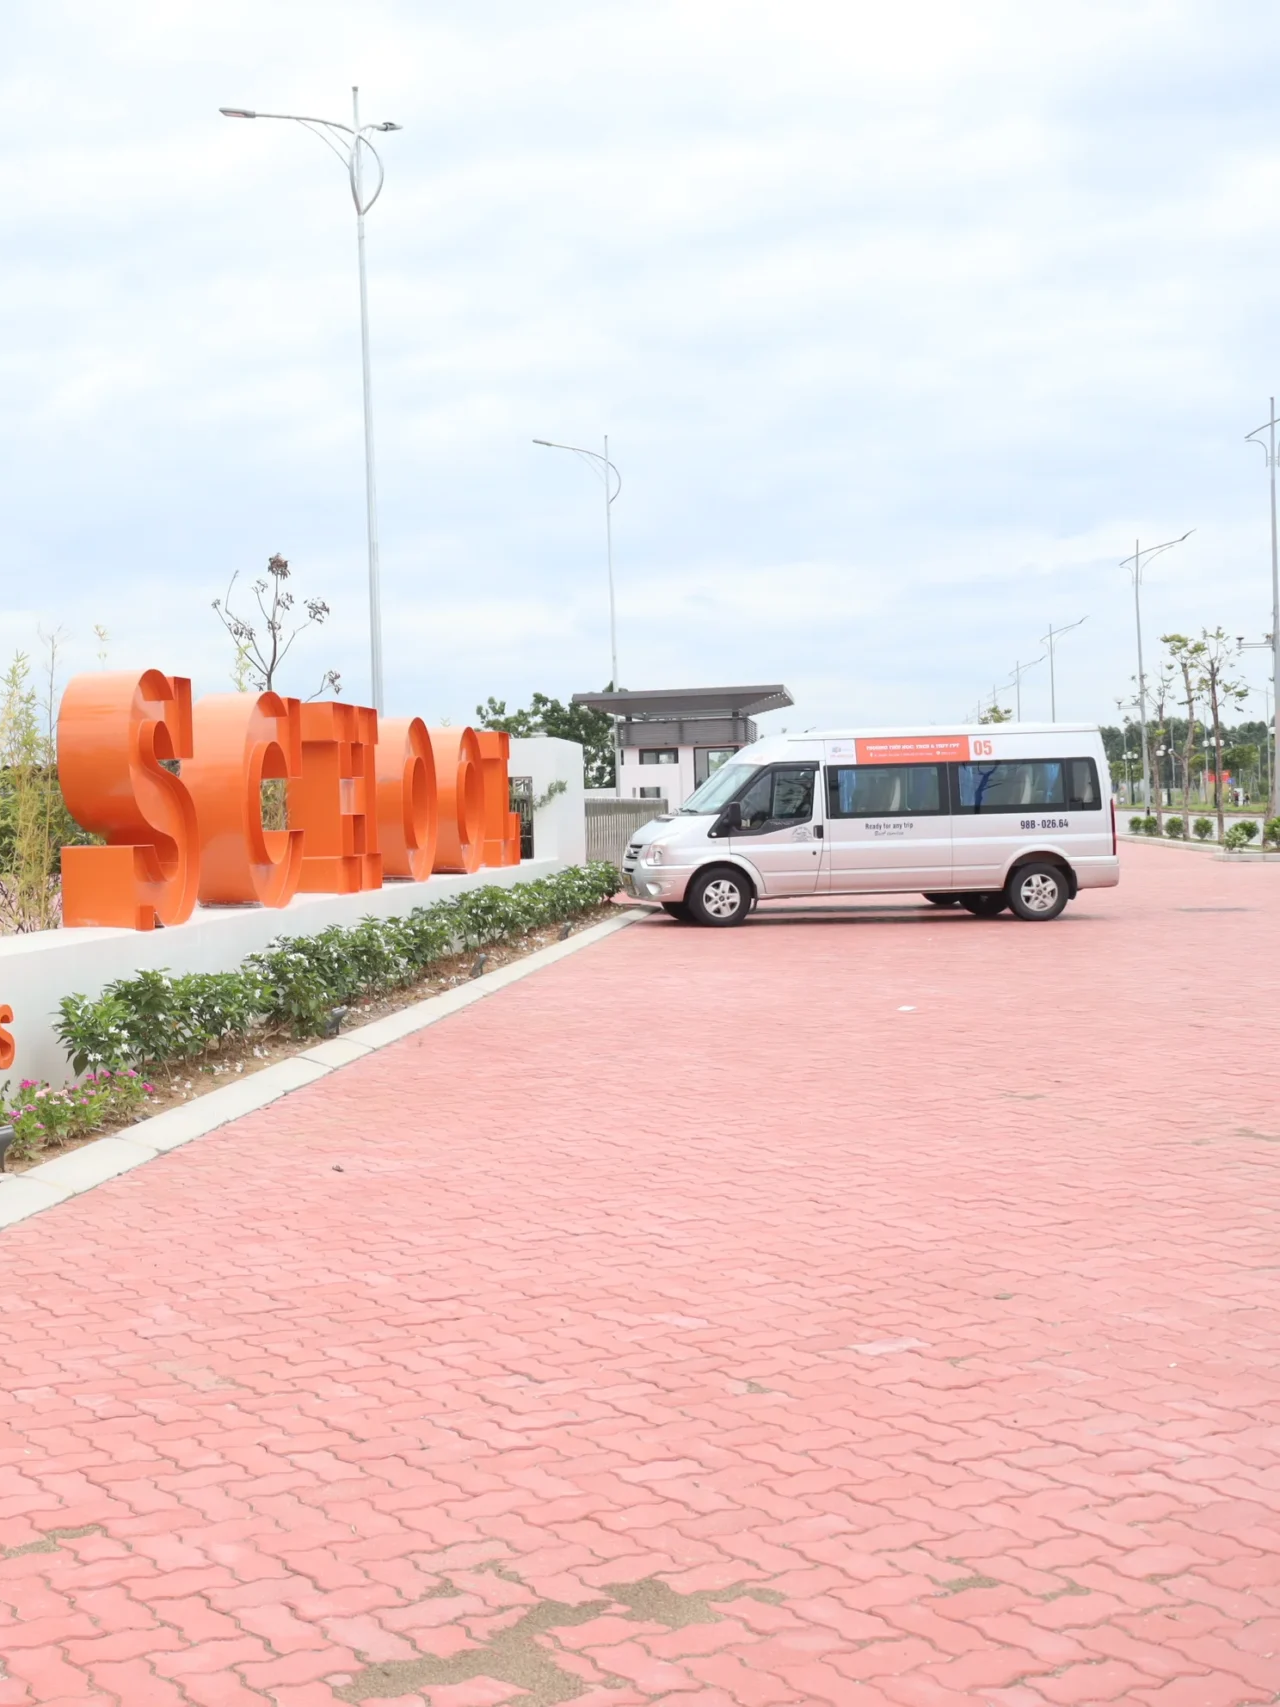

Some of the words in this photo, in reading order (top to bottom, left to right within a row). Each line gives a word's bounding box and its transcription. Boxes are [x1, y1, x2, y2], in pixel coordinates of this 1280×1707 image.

[973, 740, 992, 756] 05
[57, 668, 521, 932] SCHOOL
[903, 822, 914, 830] trip
